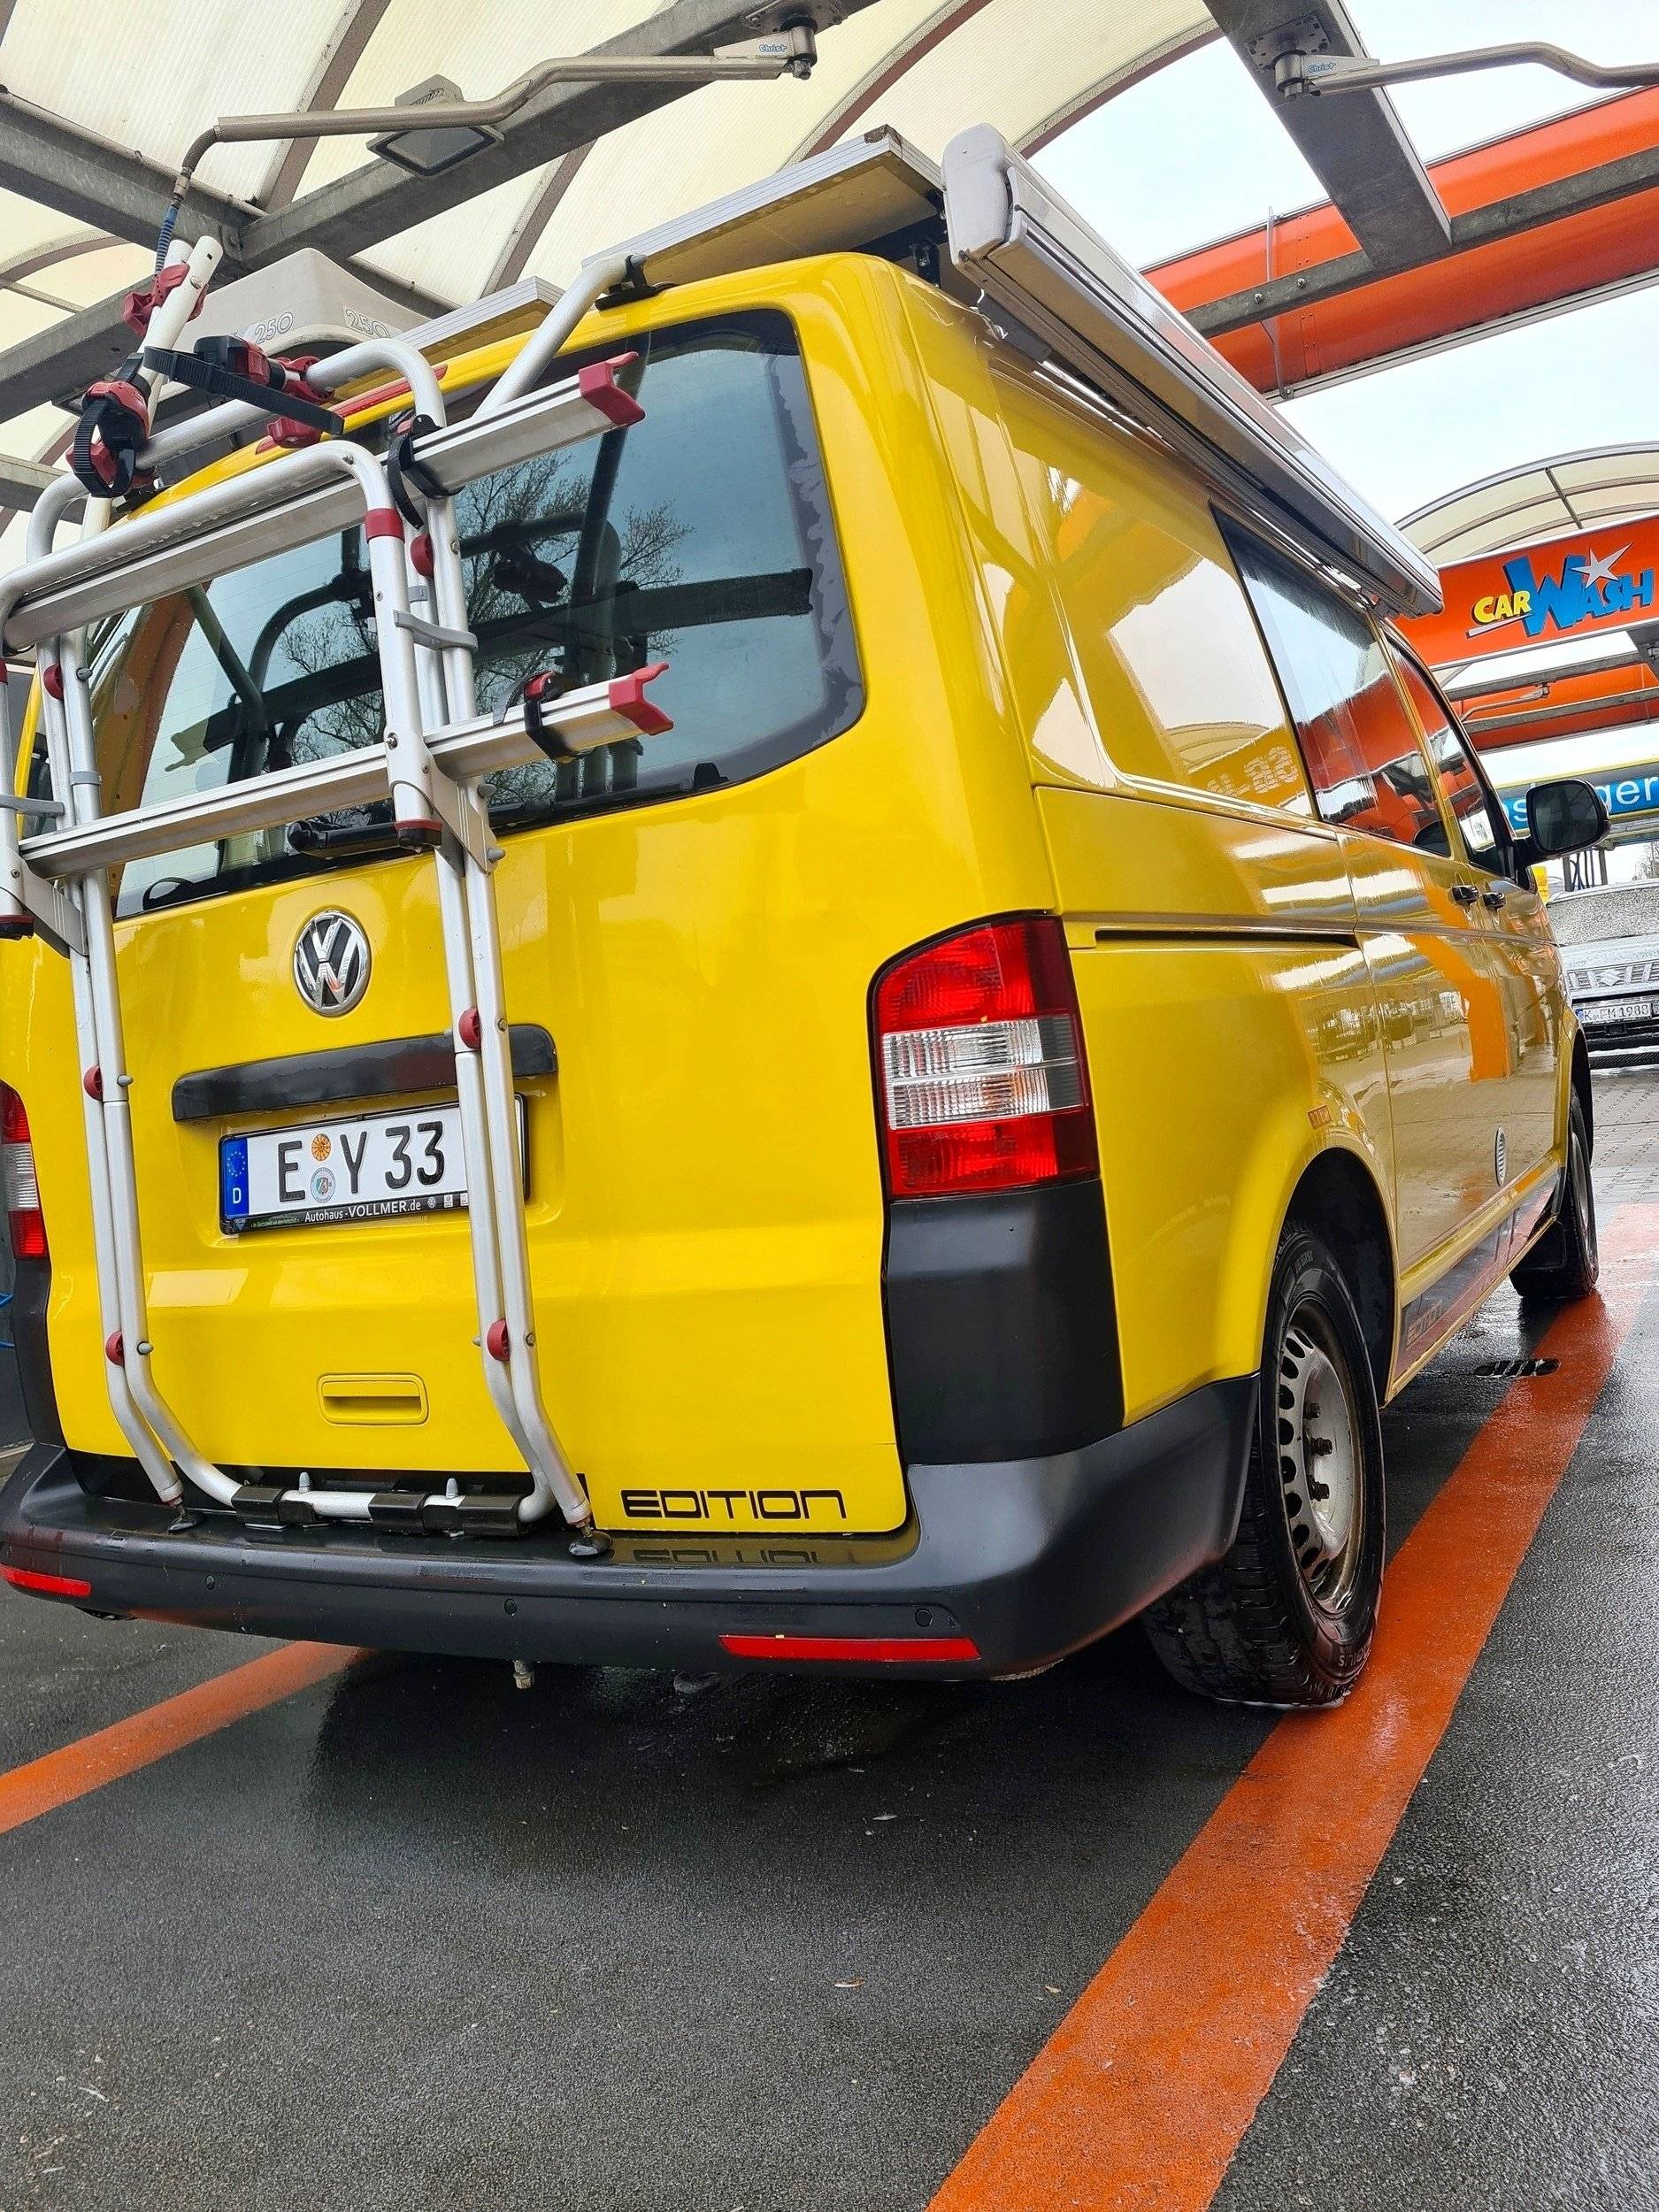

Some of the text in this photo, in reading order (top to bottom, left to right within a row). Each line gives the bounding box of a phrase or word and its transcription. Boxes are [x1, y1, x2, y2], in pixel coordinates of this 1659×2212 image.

[254, 311, 294, 344] 250
[345, 309, 391, 338] 250
[1471, 554, 1655, 637] CAR WASH
[1584, 1010, 1593, 1021] K
[277, 1140, 306, 1202] E
[340, 1131, 367, 1194] Y
[384, 1120, 445, 1190] 33
[233, 1187, 242, 1204] D
[304, 1209, 343, 1223] Autohaus
[620, 1489, 848, 1519] EDITION
